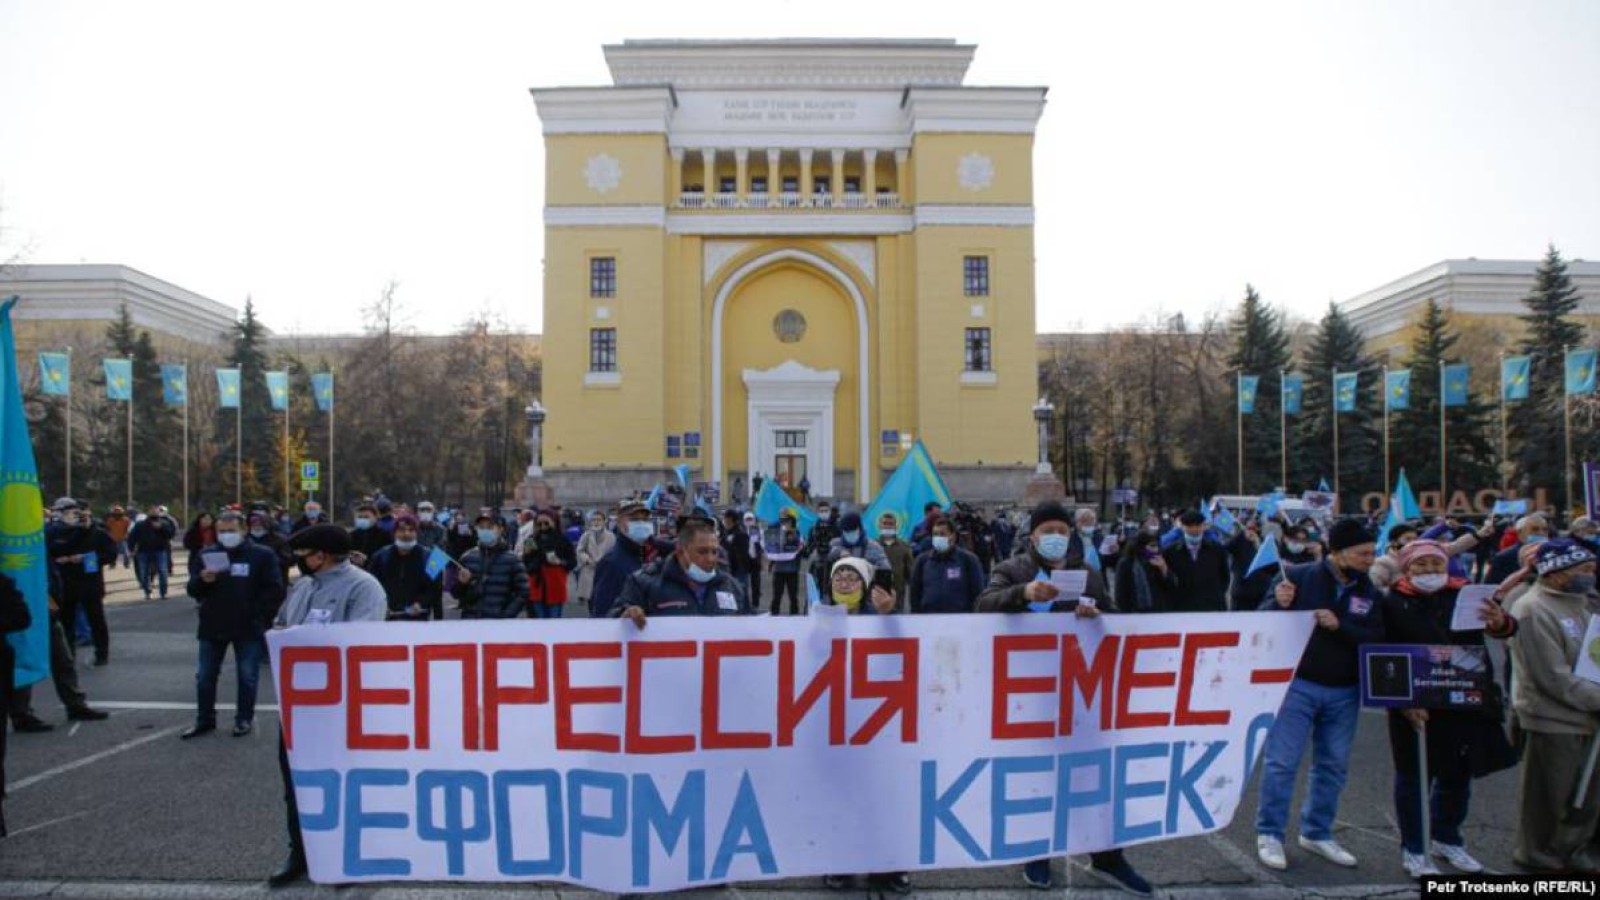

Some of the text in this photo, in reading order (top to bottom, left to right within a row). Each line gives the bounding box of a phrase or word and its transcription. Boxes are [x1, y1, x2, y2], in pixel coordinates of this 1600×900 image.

[279, 638, 919, 754] РЕПРЕССИЯ
[295, 768, 777, 888] РЕФОРМА
[919, 739, 1228, 865] КЕРЕК
